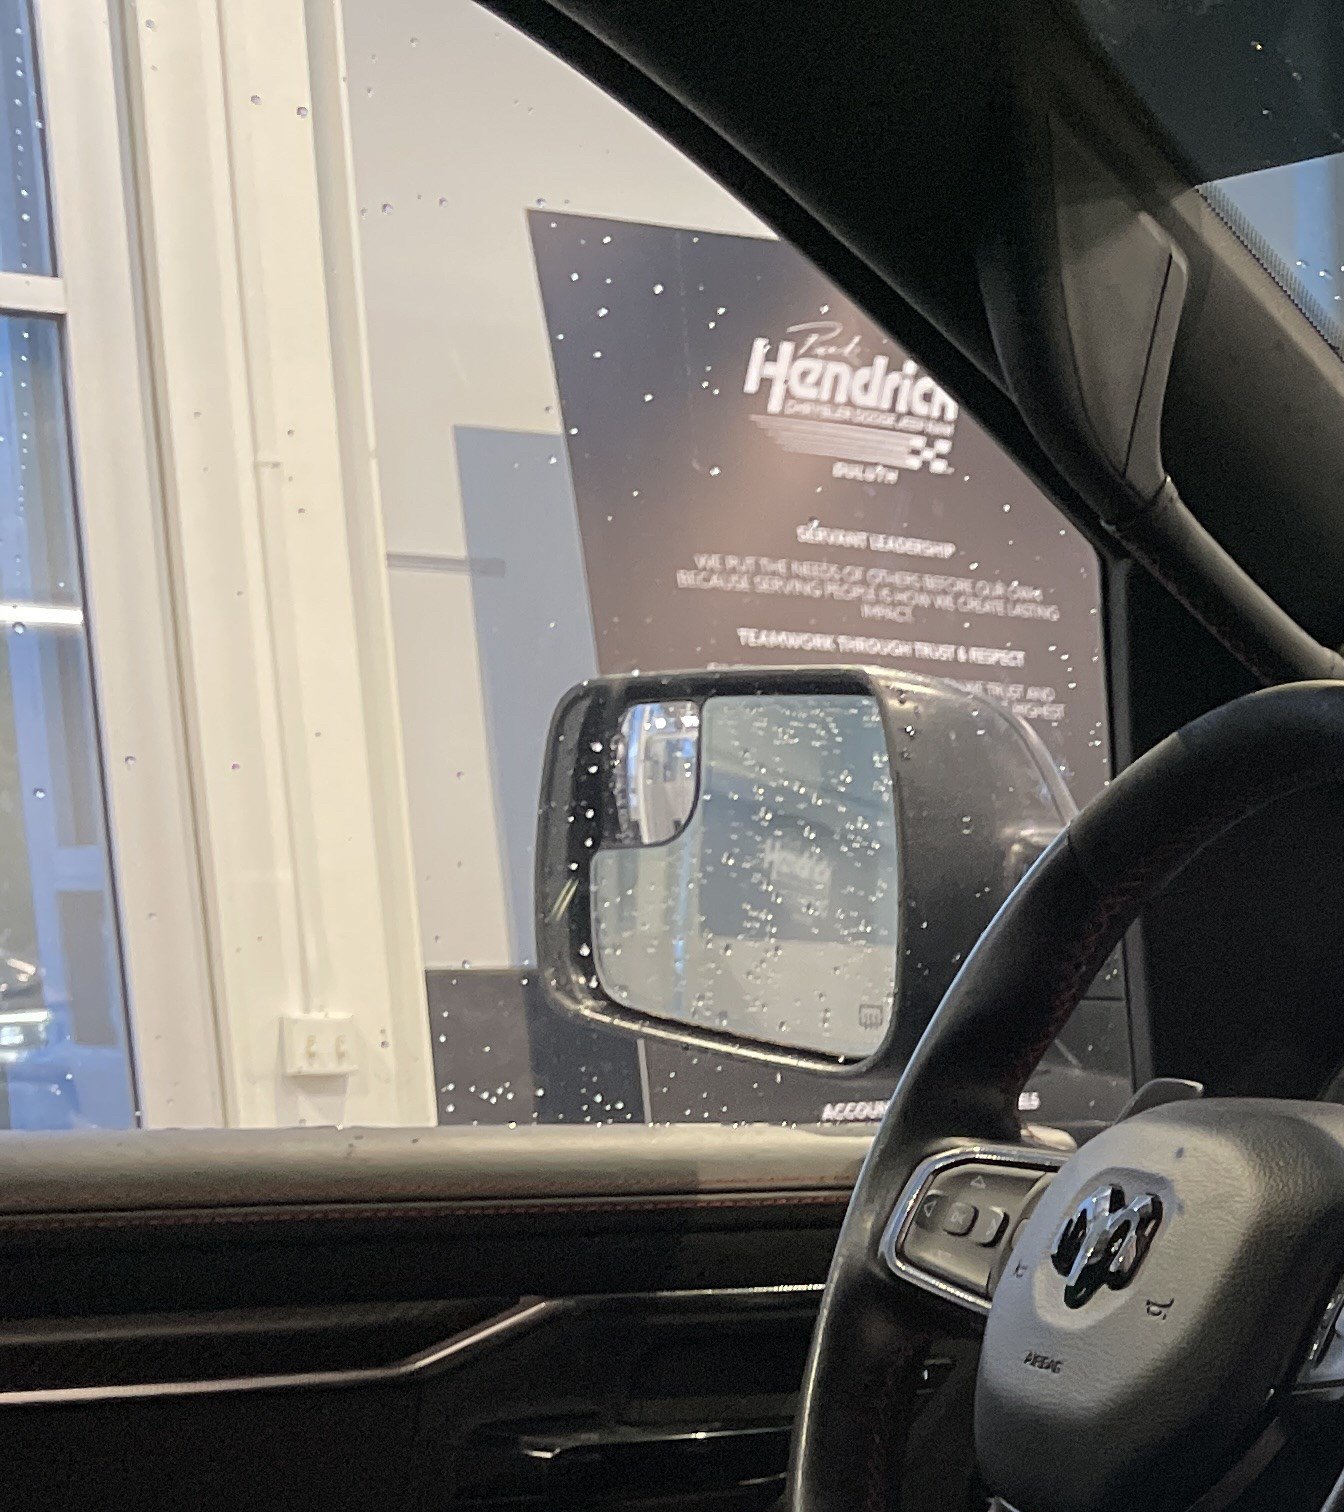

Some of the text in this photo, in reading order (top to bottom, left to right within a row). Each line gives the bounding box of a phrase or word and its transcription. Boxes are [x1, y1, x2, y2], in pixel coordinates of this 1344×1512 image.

[869, 532, 956, 558] LEADERSHIP
[736, 627, 836, 652] TEAMWORK
[837, 634, 913, 657] THROUGH
[914, 641, 956, 661] TRUST
[968, 646, 1026, 668] RESPECT
